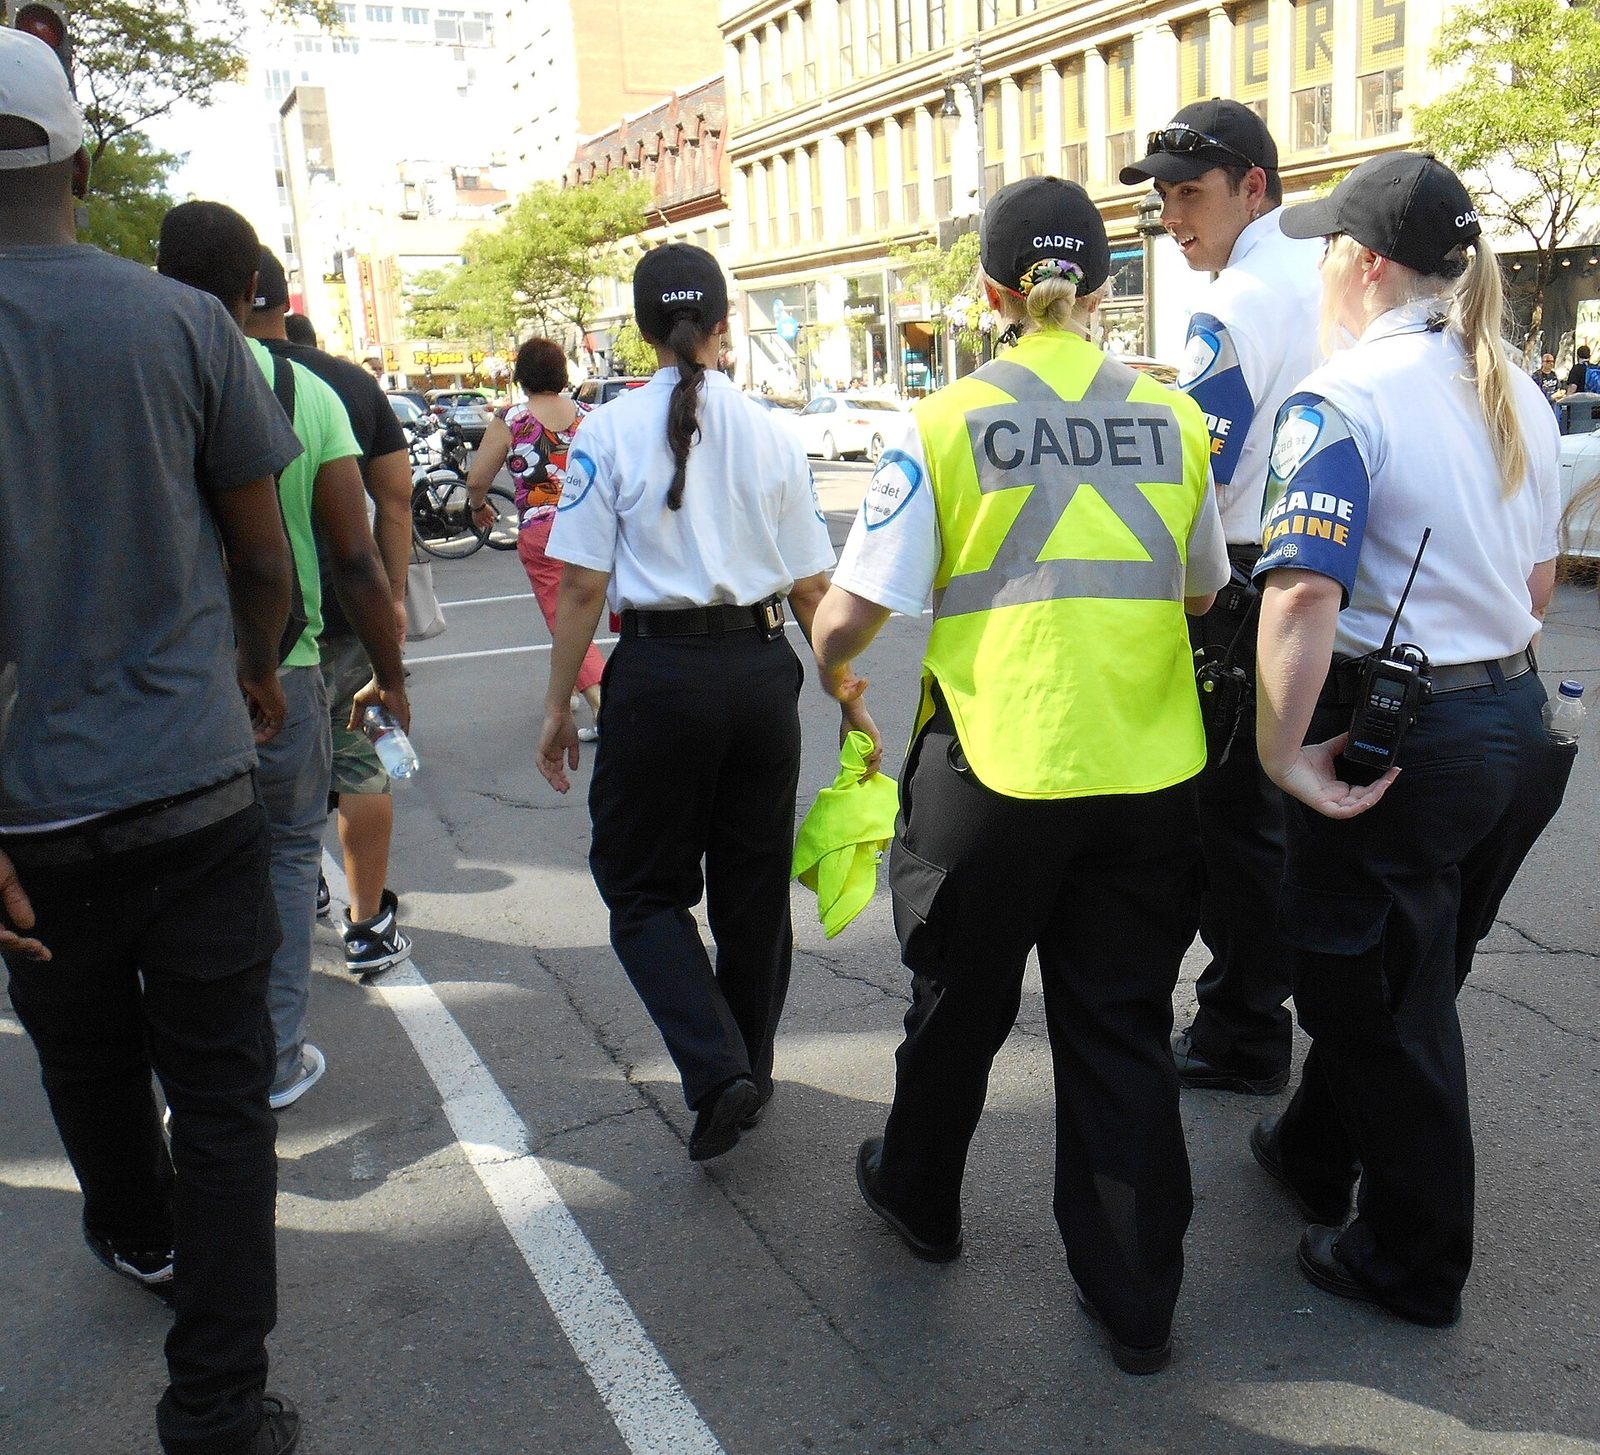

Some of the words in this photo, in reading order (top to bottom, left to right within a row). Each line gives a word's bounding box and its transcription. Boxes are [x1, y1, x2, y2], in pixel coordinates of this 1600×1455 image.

[1033, 235, 1085, 252] CADET
[662, 290, 703, 303] CADET
[984, 417, 1169, 470] CADET
